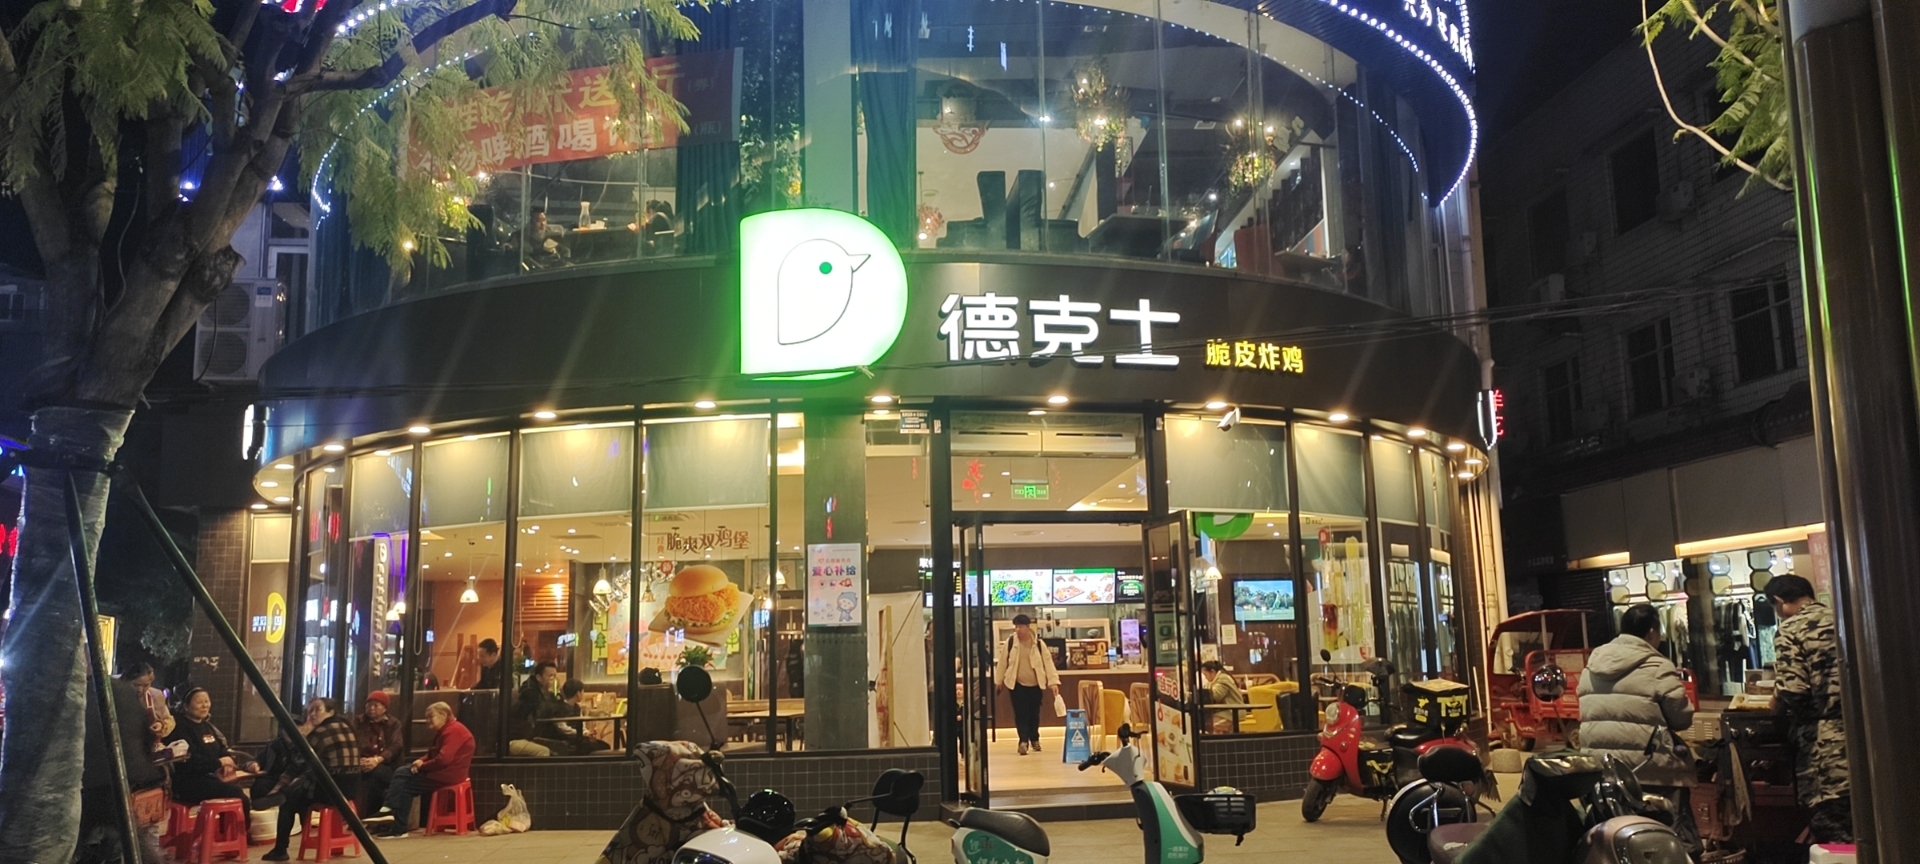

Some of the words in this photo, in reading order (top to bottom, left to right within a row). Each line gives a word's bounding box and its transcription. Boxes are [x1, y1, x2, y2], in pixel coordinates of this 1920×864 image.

[940, 292, 1181, 366] 德克士
[1206, 338, 1304, 374] 脆皮炸鸡
[666, 529, 750, 555] 脆爽双鸡堡
[812, 565, 857, 577] 爱心补给
